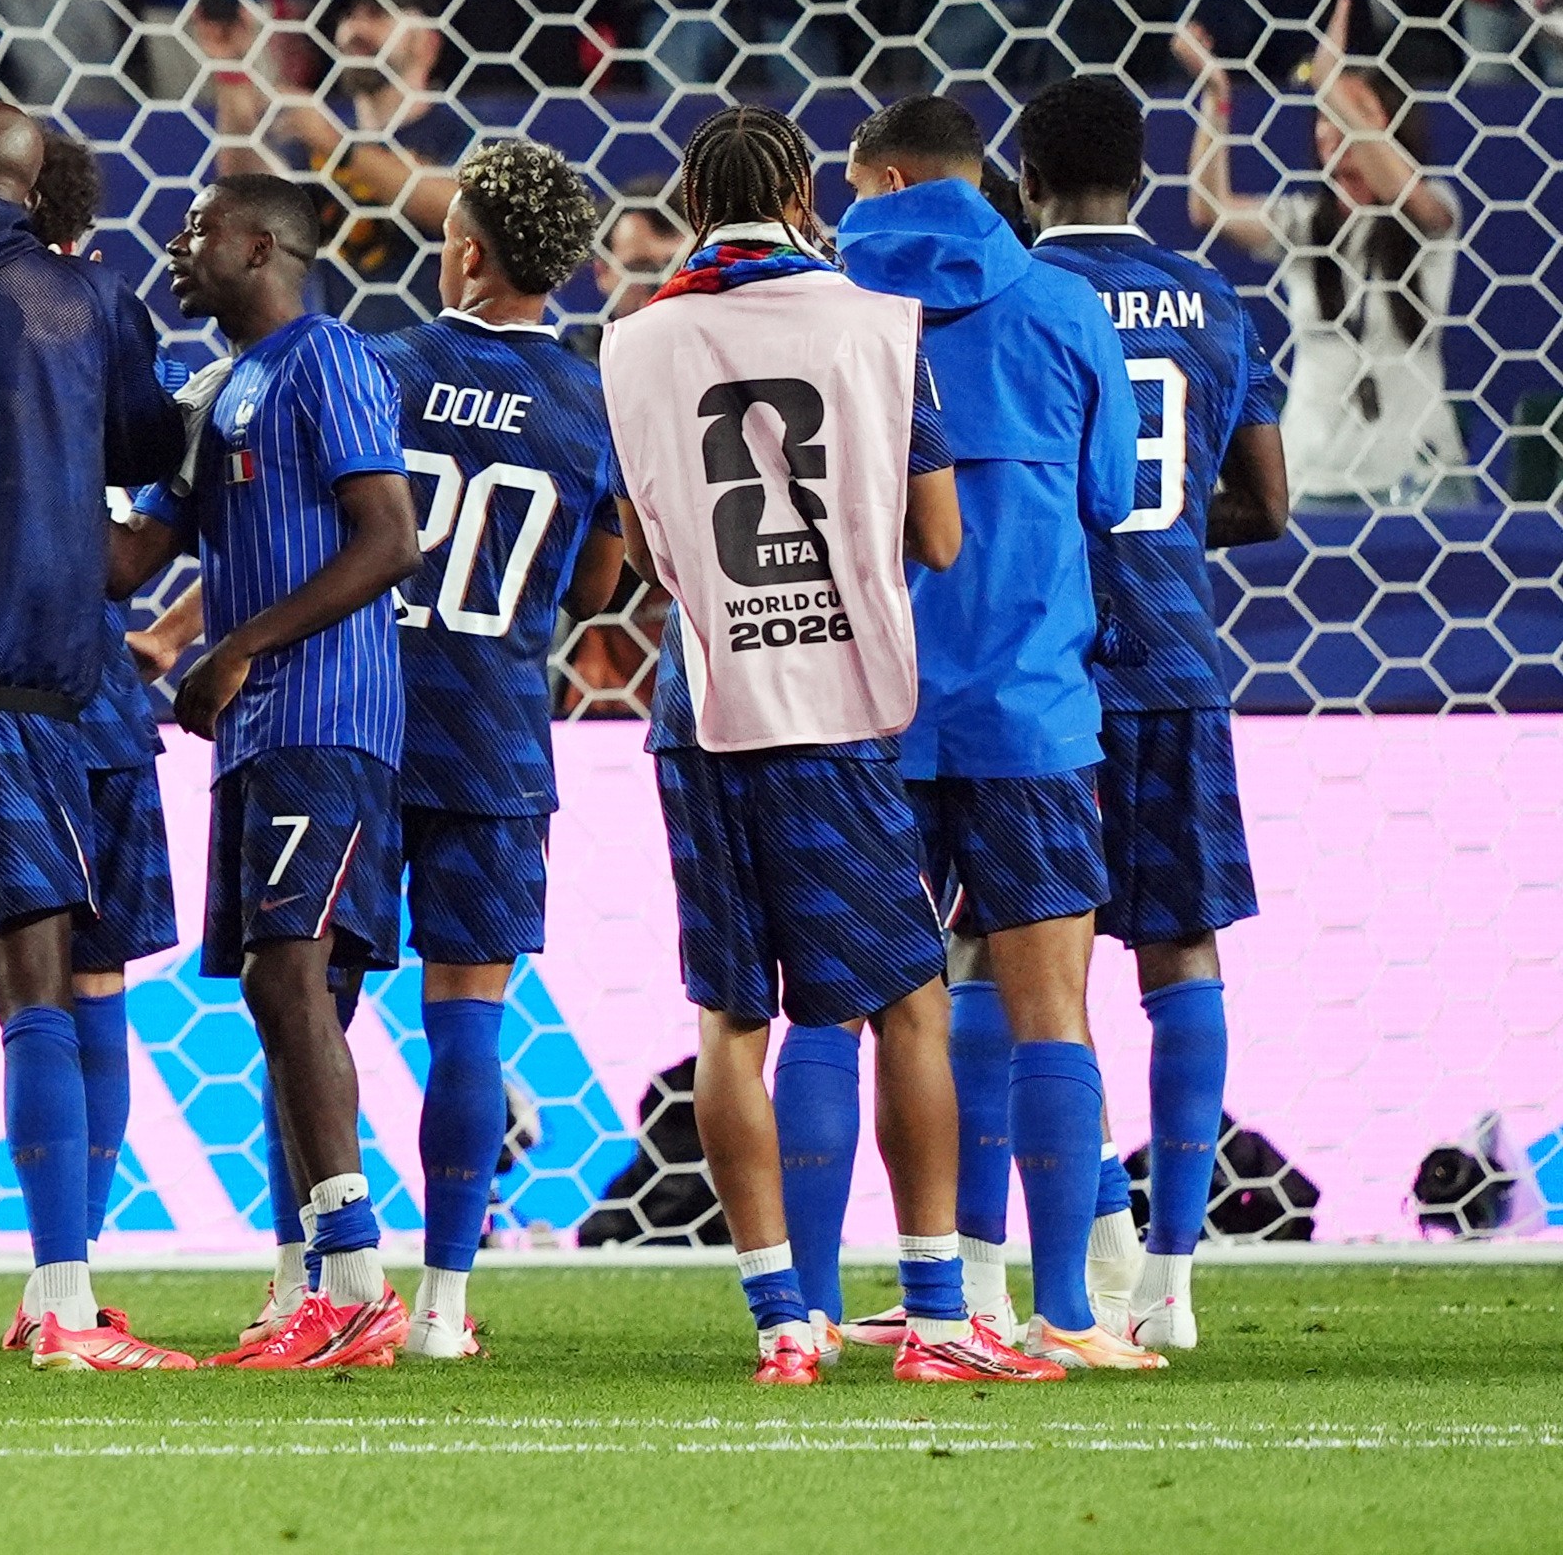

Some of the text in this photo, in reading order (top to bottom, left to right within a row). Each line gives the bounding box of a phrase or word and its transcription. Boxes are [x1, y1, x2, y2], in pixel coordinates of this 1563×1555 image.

[1096, 290, 1205, 330] URAM
[422, 381, 532, 434] DOUE
[756, 540, 819, 568] FIFA
[725, 590, 842, 619] WORLD CU
[728, 612, 855, 653] 2026
[266, 815, 311, 887] 7
